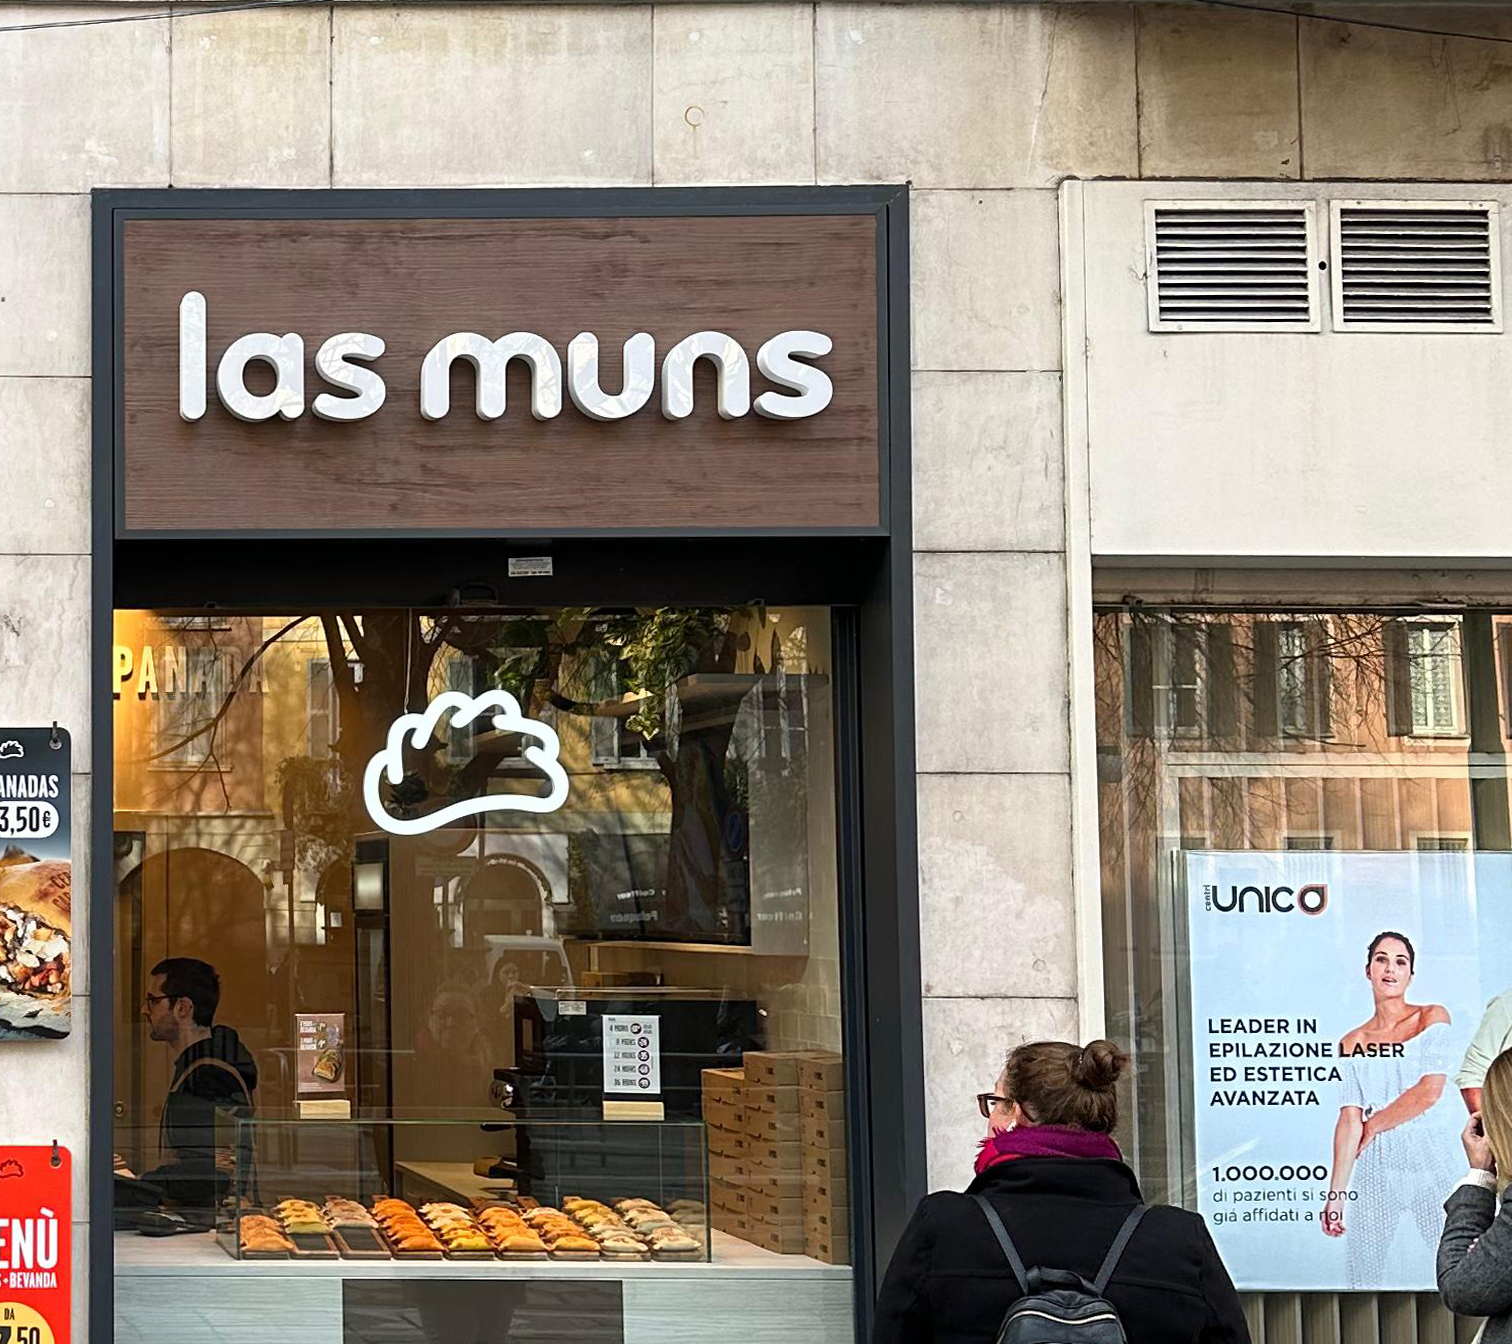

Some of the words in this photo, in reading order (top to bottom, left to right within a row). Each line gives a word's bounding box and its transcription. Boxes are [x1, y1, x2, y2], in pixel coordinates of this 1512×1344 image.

[178, 290, 387, 423] las
[419, 329, 834, 422] muns
[113, 645, 271, 694] PANADA
[1208, 1018, 1290, 1034] LEADER
[1296, 1018, 1317, 1034] IN
[1209, 1042, 1333, 1058] EPILAZIONE
[1339, 1042, 1405, 1058] LASER
[1210, 1066, 1237, 1082] ED
[1244, 1066, 1343, 1082] ESTETICA
[1210, 1090, 1320, 1106] AVANZATA
[1212, 1165, 1328, 1182] 1.000.000
[1213, 1189, 1227, 1203] di
[1233, 1188, 1297, 1204] pazienti
[1302, 1187, 1314, 1201] si
[1319, 1190, 1359, 1202] sono
[1242, 1208, 1299, 1223] affidati
[1304, 1211, 1314, 1222] a
[1319, 1209, 1343, 1222] noi
[9, 1272, 58, 1289] BEVANDA
[4, 1308, 15, 1321] DA
